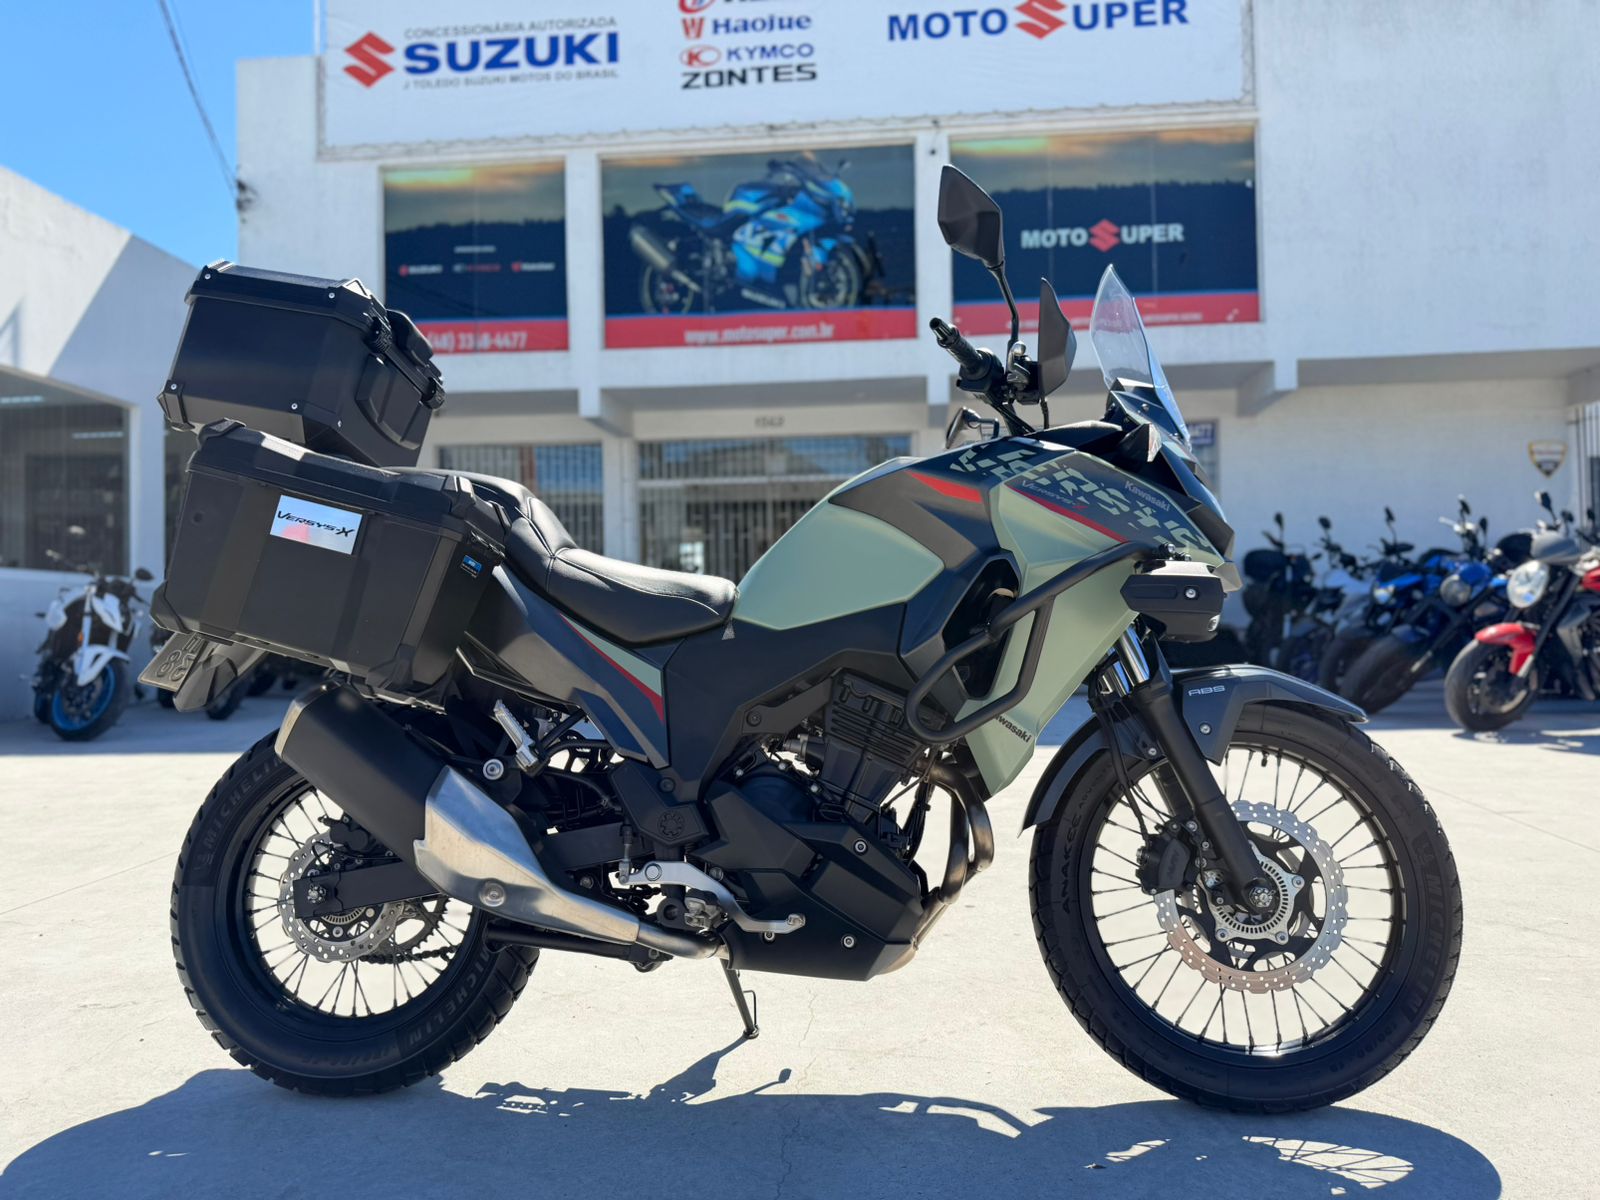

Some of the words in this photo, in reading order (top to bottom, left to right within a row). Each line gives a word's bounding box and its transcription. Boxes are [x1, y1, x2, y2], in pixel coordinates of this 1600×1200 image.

[528, 16, 617, 31] AUTORIZADA
[712, 14, 811, 35] Haojue
[888, 8, 1008, 41] MOTO
[404, 31, 619, 75] SUZUKI
[726, 43, 814, 61] KYMCO
[413, 77, 460, 89] TOLEDO
[464, 74, 505, 87] SUZUKI
[509, 71, 552, 84] MOTOS
[555, 70, 573, 82] DO
[575, 68, 619, 80] BRASIL
[681, 63, 817, 90] ZONTES
[1021, 227, 1088, 248] MOTO
[1124, 480, 1171, 512] Kawasaki
[1188, 685, 1225, 697] ABS
[1061, 813, 1081, 914] ANAKEE
